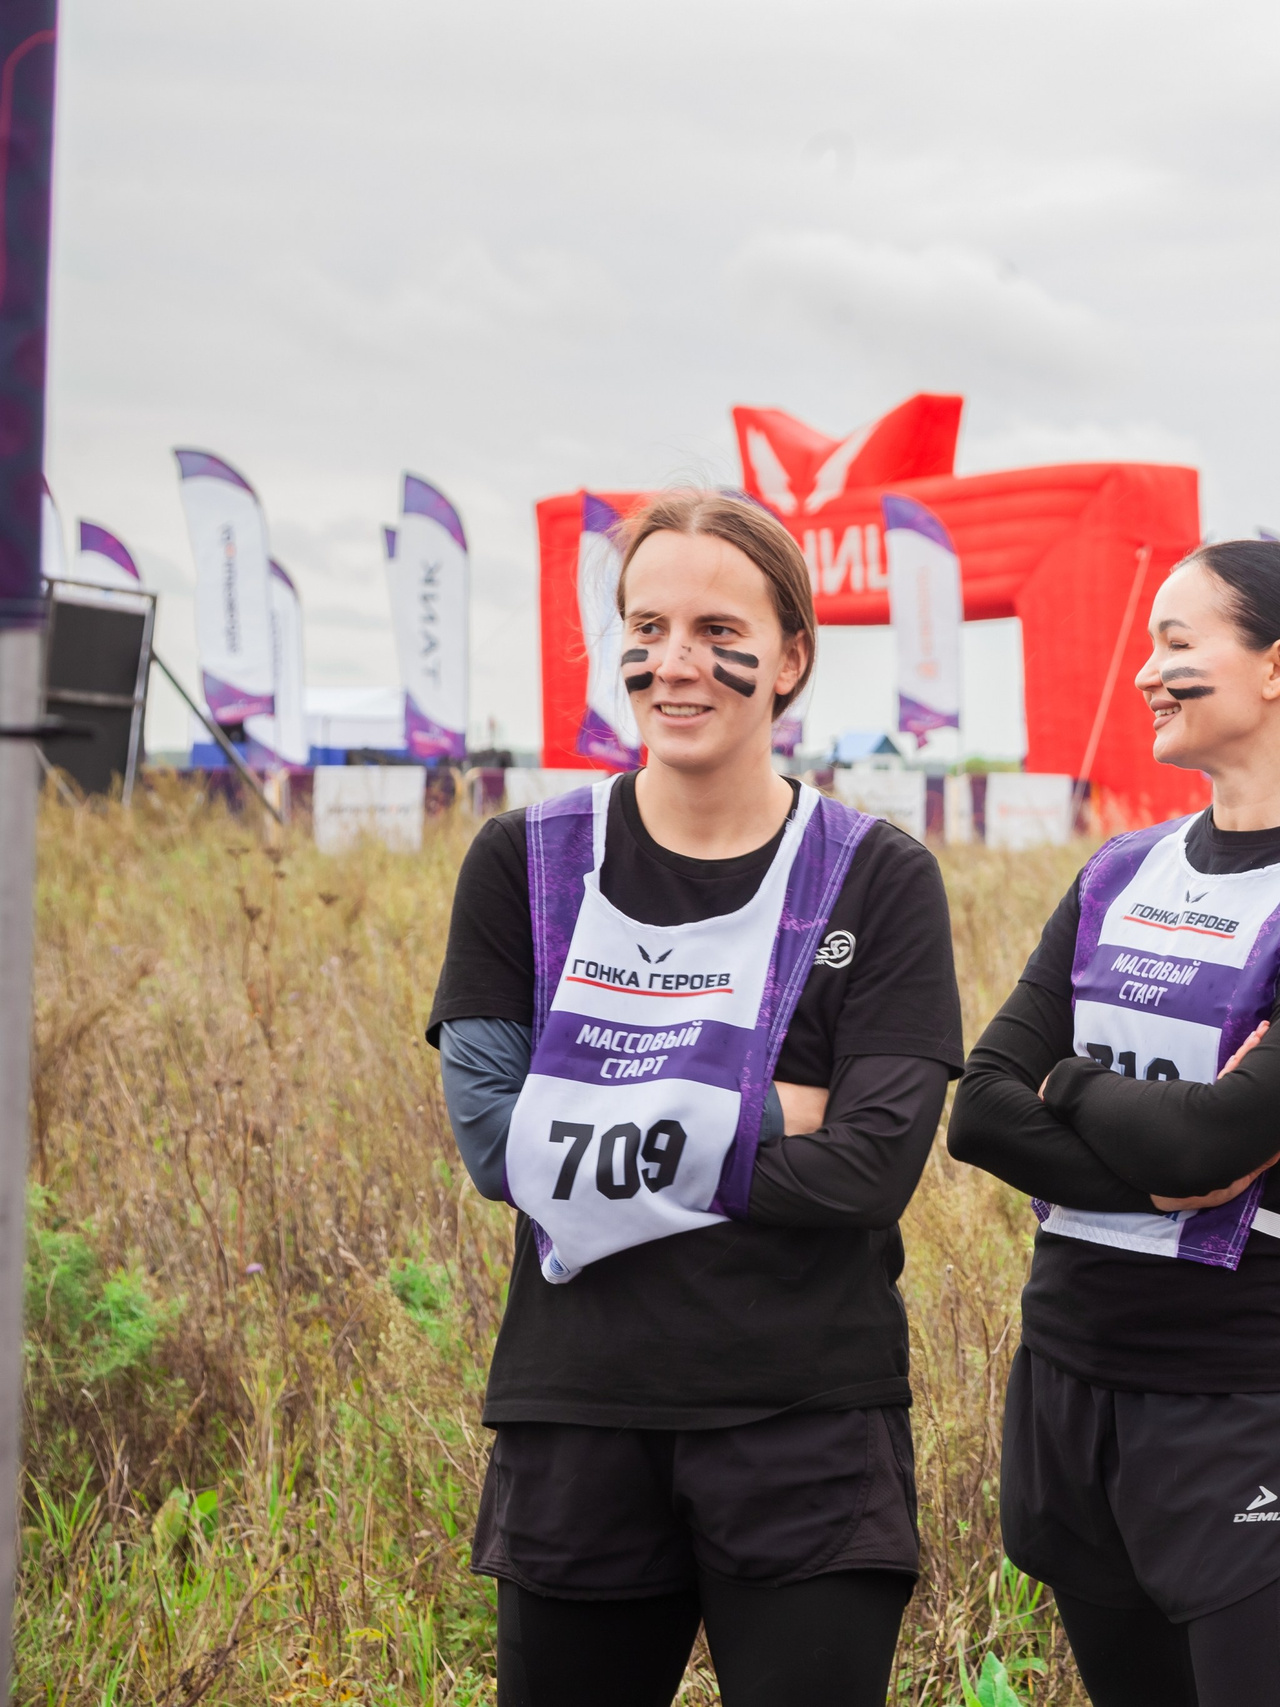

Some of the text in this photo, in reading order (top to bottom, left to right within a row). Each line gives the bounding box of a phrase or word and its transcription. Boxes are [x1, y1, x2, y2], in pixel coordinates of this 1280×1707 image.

[1130, 903, 1240, 933] ГОНКА ГЕРОЕВ
[572, 959, 731, 990] ГОНКА ГЕРОЕВ
[1110, 952, 1202, 986] МАССОВЫЙ
[1118, 980, 1168, 1007] СТАРТ
[575, 1020, 703, 1054] МАССОВЫЙ
[600, 1055, 669, 1079] СТАРТ
[549, 1119, 688, 1201] 709
